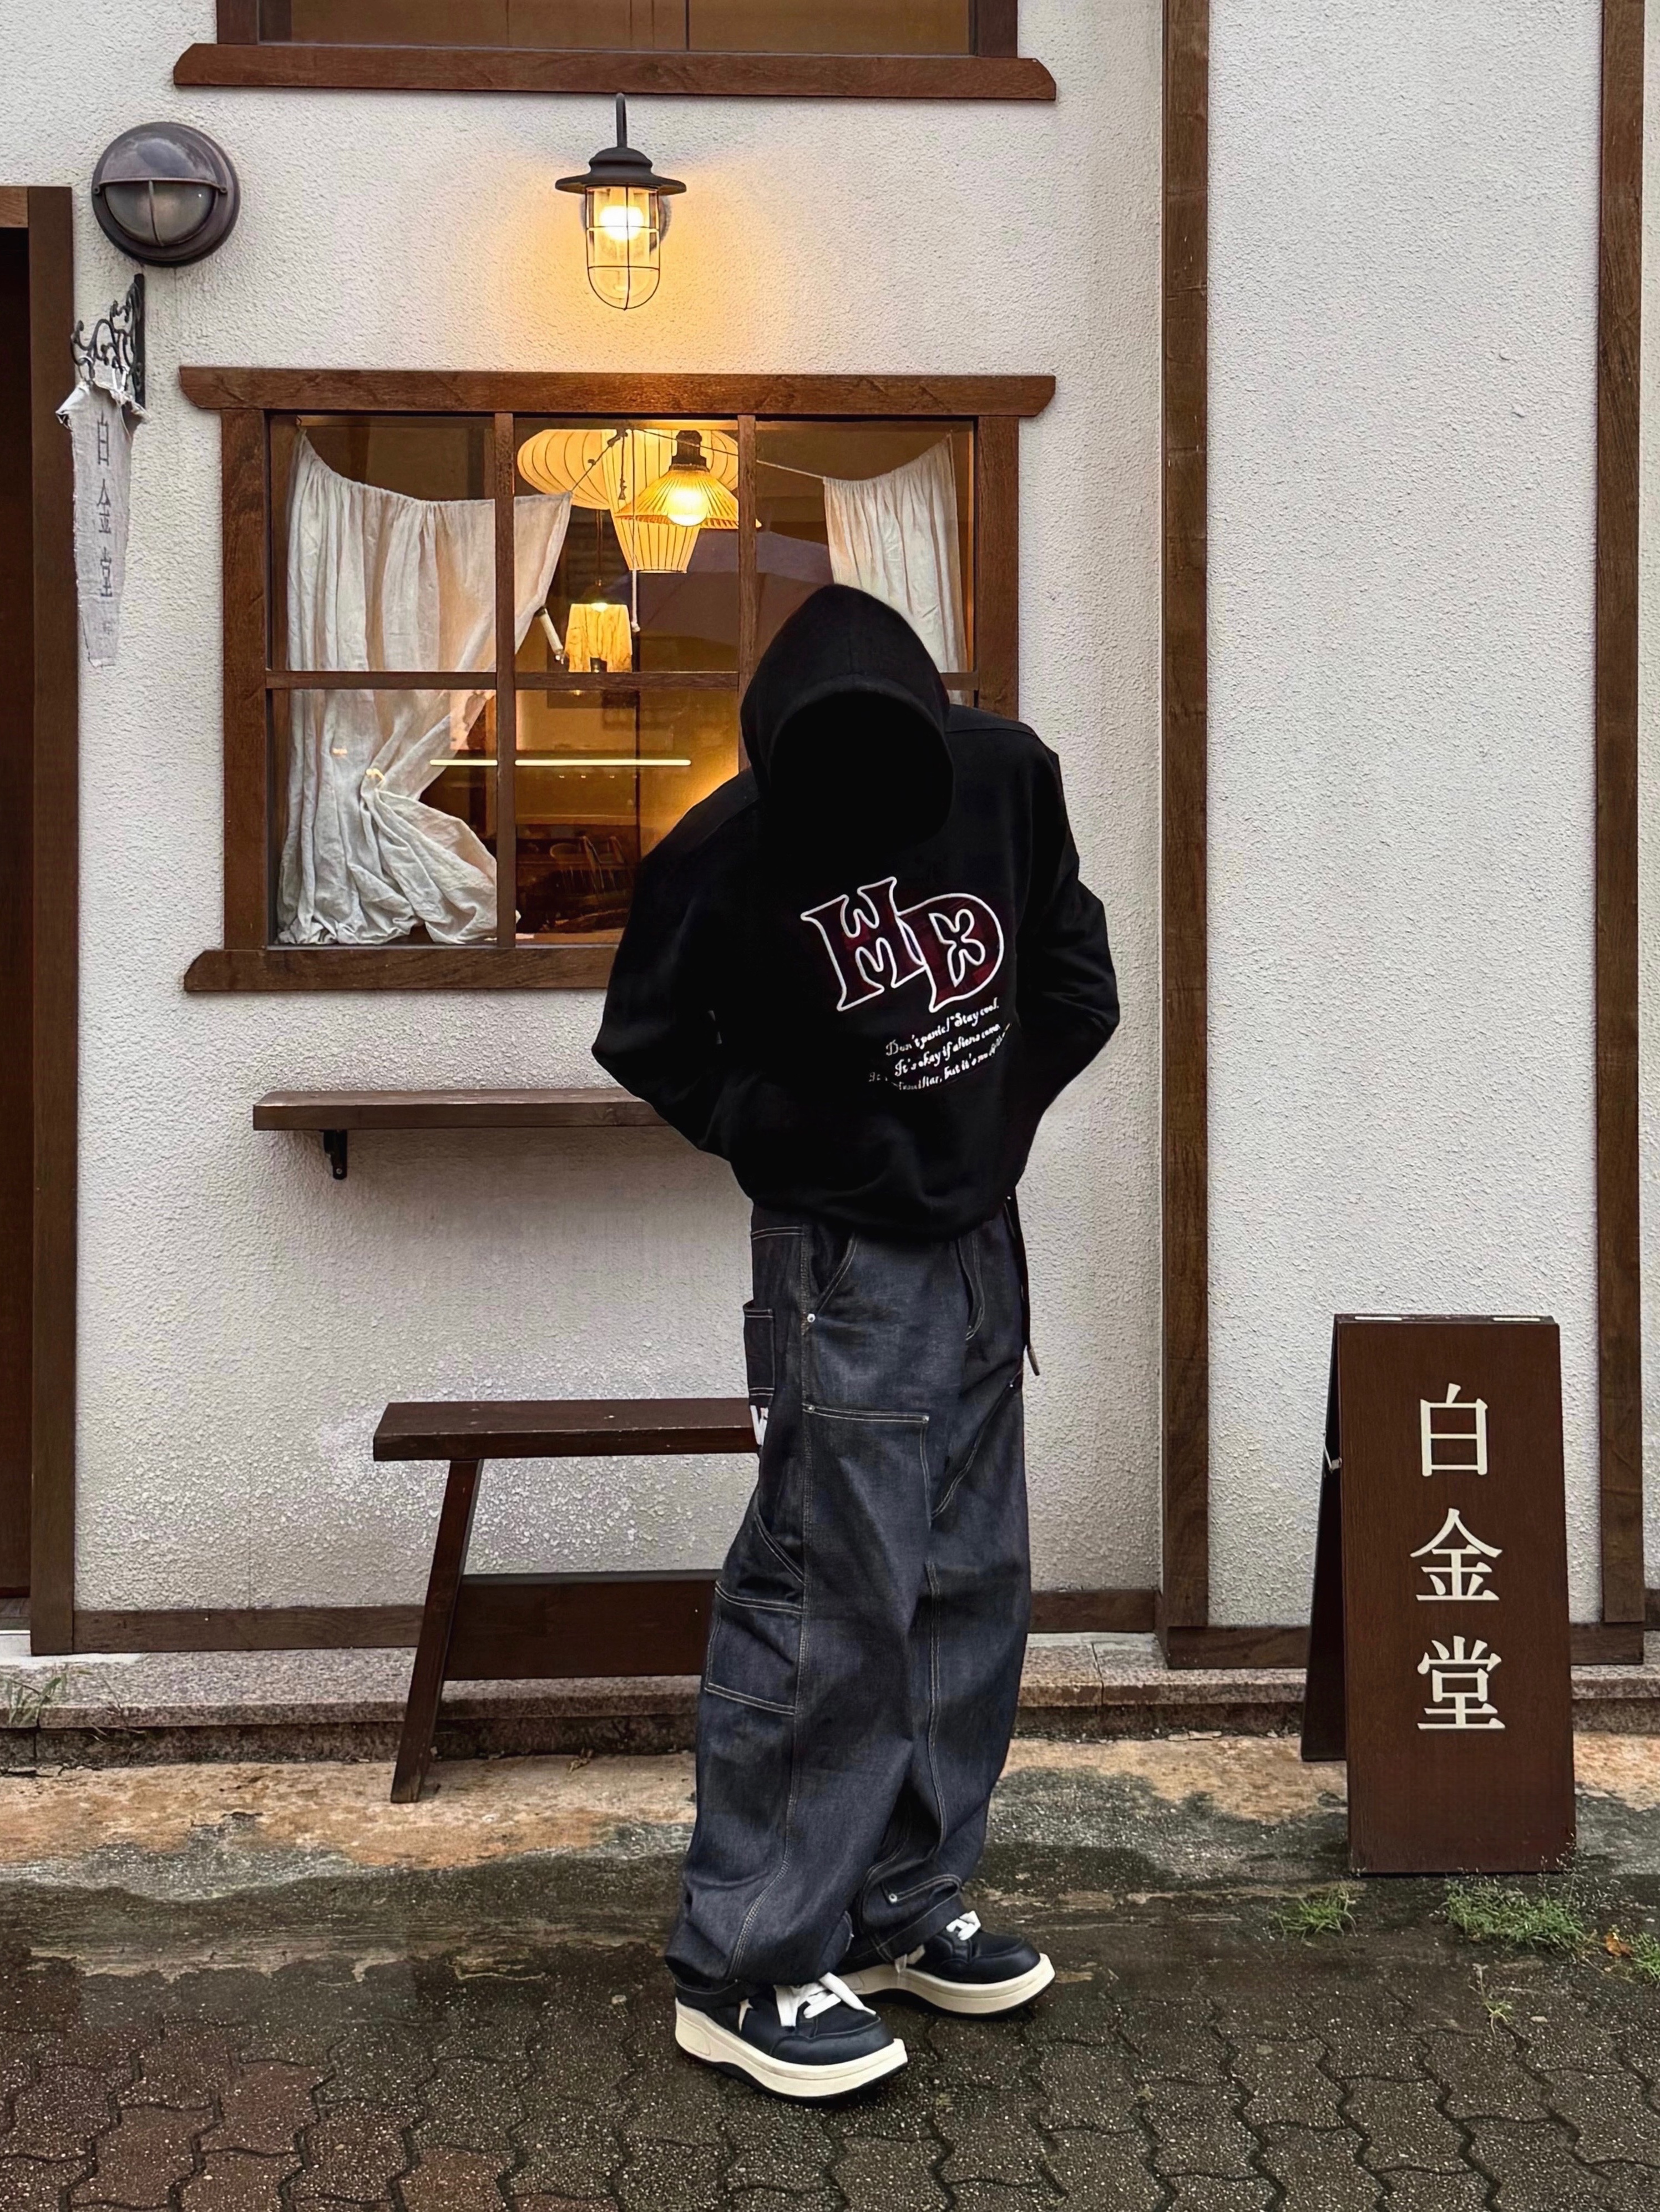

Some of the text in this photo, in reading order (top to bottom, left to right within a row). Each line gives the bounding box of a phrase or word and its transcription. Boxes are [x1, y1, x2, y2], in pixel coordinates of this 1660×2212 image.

[885, 1034, 920, 1056] Don't
[950, 1012, 979, 1027] Stay
[894, 1058, 917, 1077] It's
[918, 1051, 942, 1067] okay
[942, 1041, 953, 1061] if
[952, 1036, 980, 1052] aliens
[1410, 1383, 1505, 1730] 白金堂
